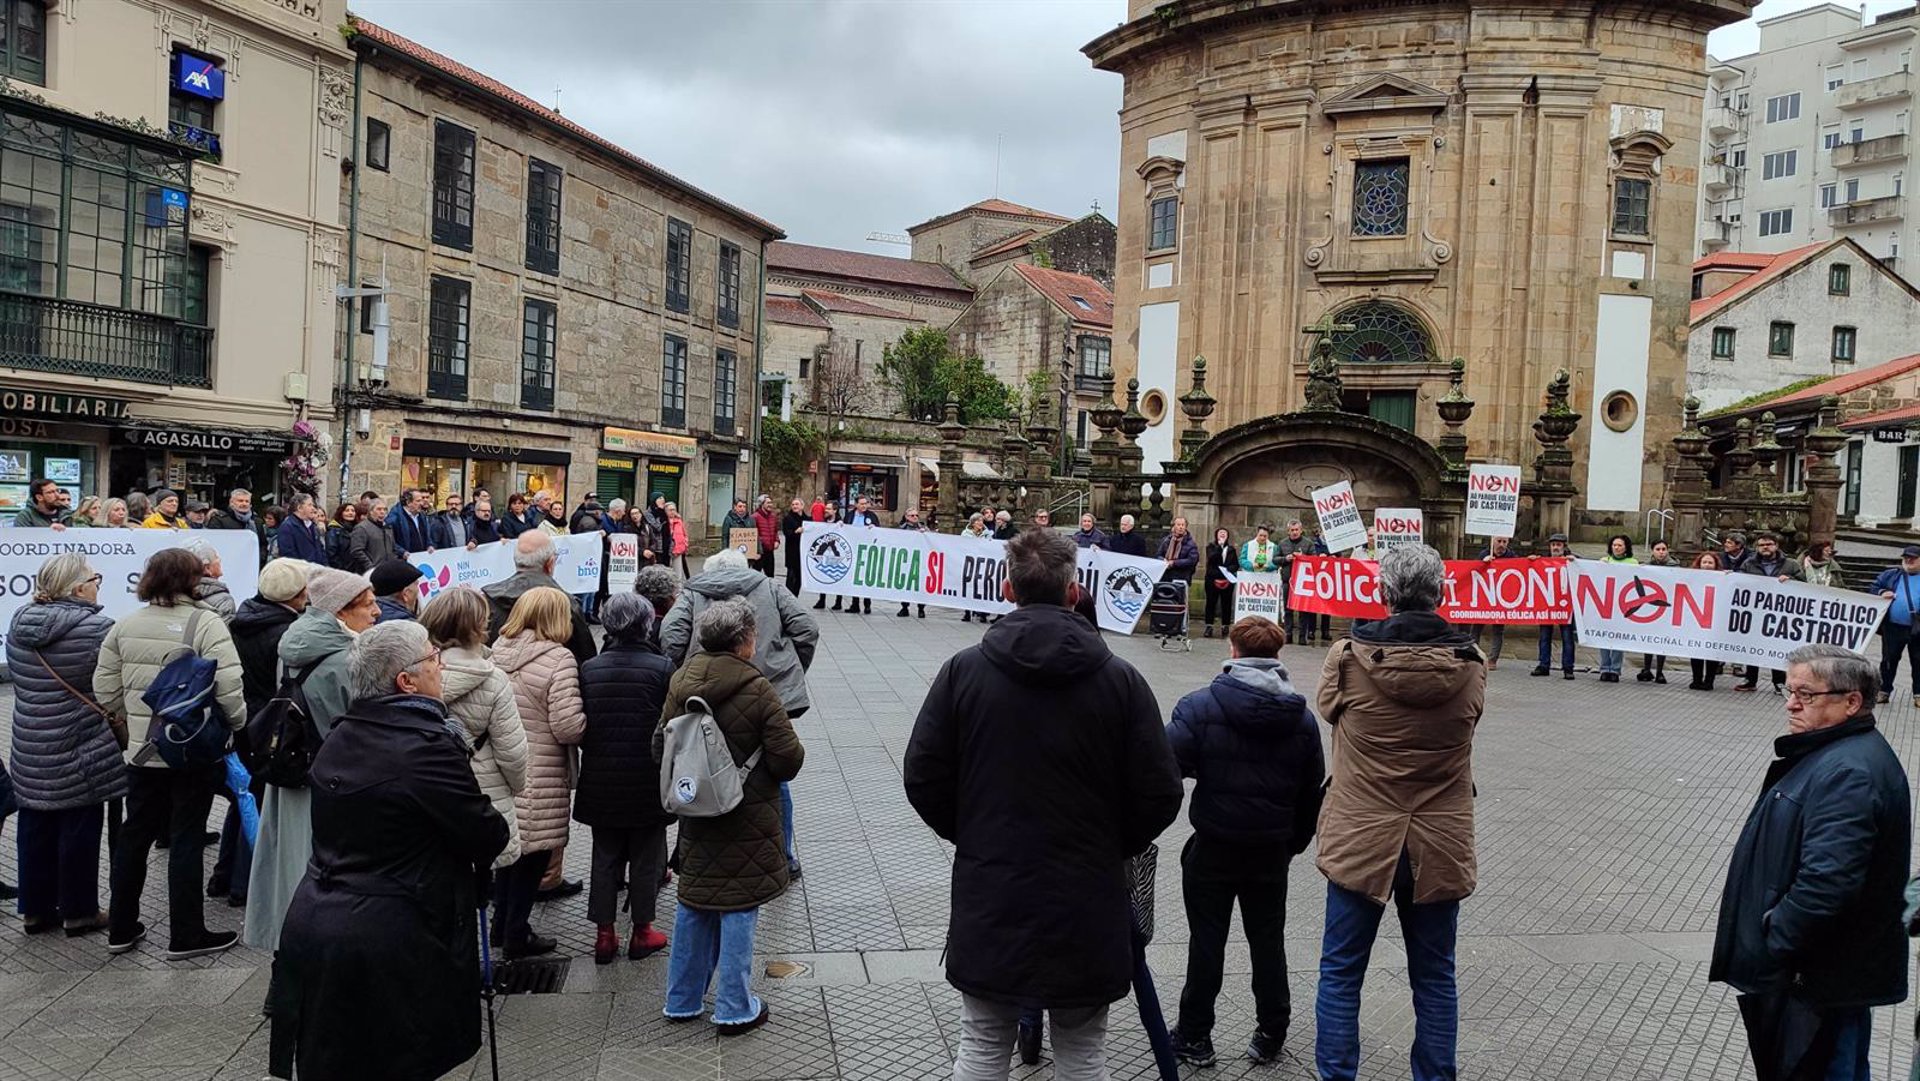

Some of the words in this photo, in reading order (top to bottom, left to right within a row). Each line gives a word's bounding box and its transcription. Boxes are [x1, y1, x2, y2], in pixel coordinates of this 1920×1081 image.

[184, 71, 210, 90] AXA
[144, 431, 232, 449] AGASALLO
[1879, 430, 1903, 440] BAR
[1471, 474, 1518, 493] NON
[1317, 490, 1354, 513] NON
[1470, 500, 1478, 509] DO
[1481, 501, 1515, 512] CASTROVE
[1323, 522, 1332, 531] DO
[1376, 518, 1420, 533] NON
[1377, 541, 1385, 549] DO
[457, 560, 470, 570] NIN
[577, 566, 598, 577] bng
[853, 538, 921, 591] EÓLICA
[962, 556, 1007, 602] PERO
[1239, 582, 1278, 597] NON
[1470, 566, 1568, 608] NON!
[1238, 603, 1246, 611] DO
[1248, 604, 1277, 613] CASTROVE
[1577, 574, 1715, 630] NON
[1731, 588, 1751, 607] AO
[1754, 591, 1817, 616] PARQUE
[1820, 599, 1878, 625] EÓLICO
[1450, 610, 1505, 620] COORDINADORA
[1506, 610, 1533, 620] EÓLICA
[1536, 609, 1548, 619] ASÍ
[1551, 611, 1568, 620] NON
[1728, 609, 1752, 634] DO
[1640, 634, 1683, 646] VECIÑAL
[1688, 640, 1701, 648] EN
[1705, 641, 1747, 653] DEFENSA
[1750, 647, 1764, 656] DO
